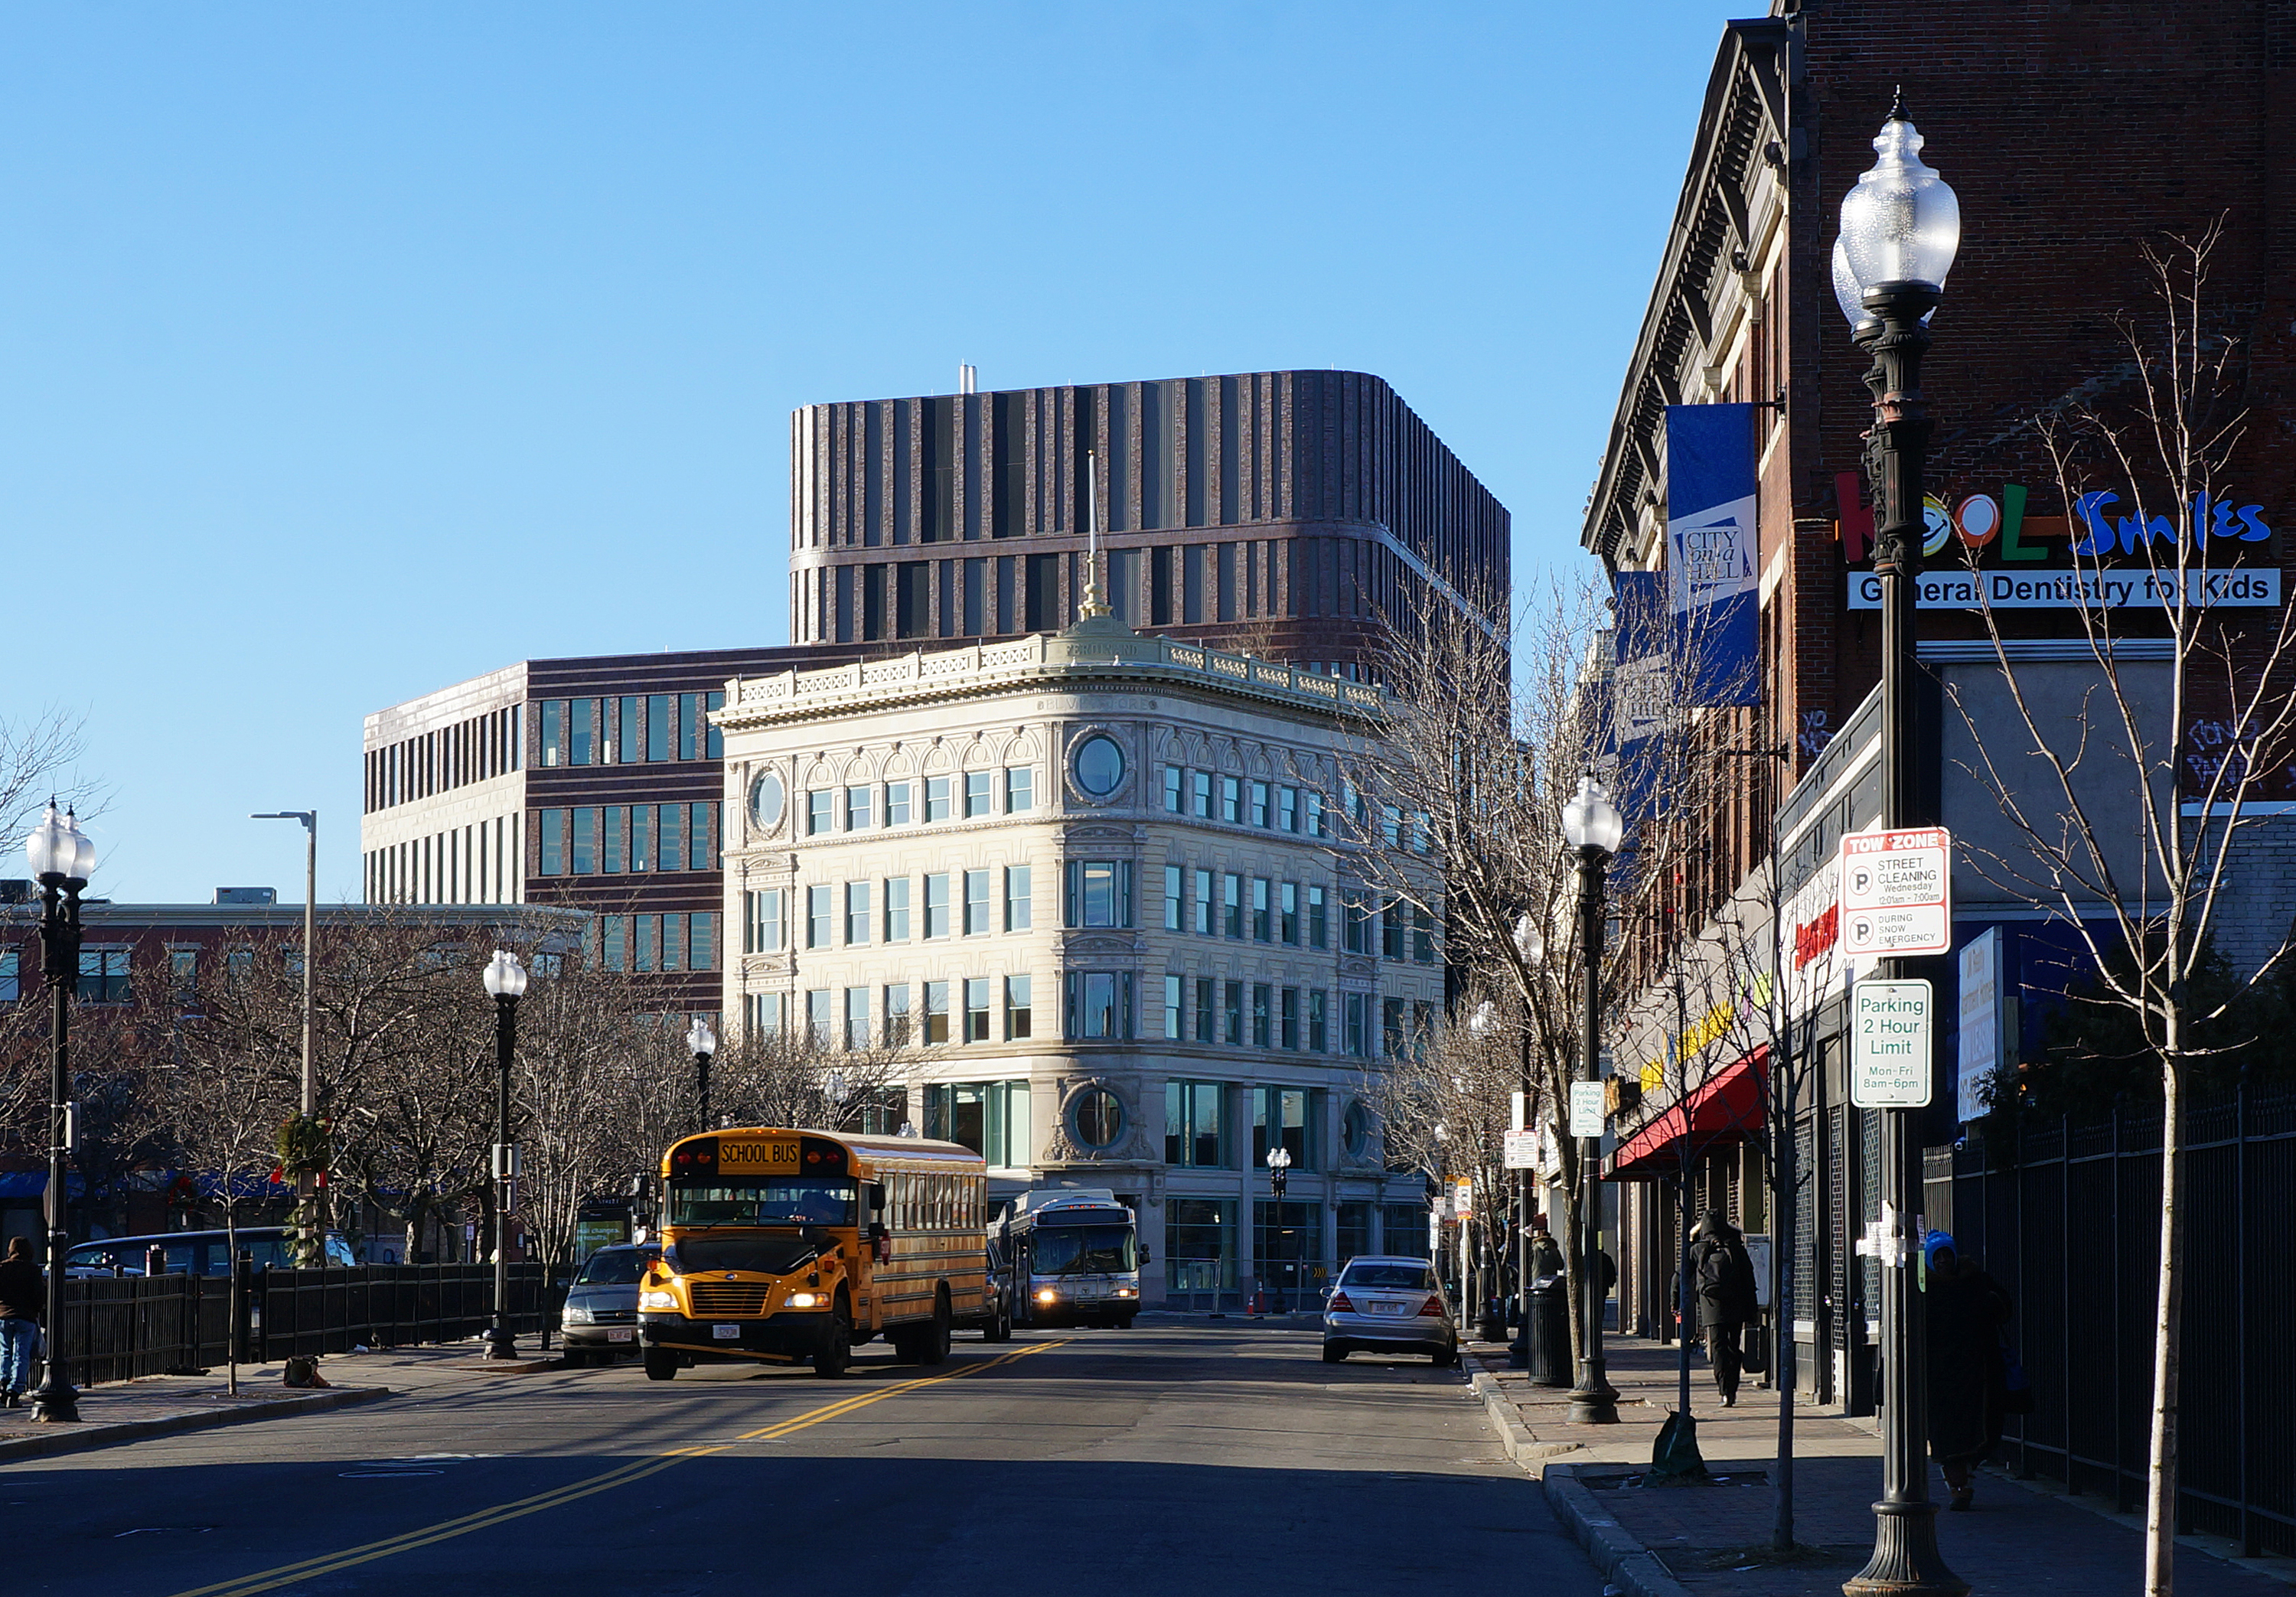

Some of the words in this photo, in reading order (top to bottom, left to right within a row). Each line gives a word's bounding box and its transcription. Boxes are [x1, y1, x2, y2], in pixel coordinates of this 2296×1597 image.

[1686, 530, 1739, 549] CITY
[1687, 562, 1740, 580] HILL
[1861, 576, 1981, 601] Gera
[1993, 575, 2134, 606] Dentistry
[2200, 575, 2269, 600] Kids
[1850, 836, 1884, 854] TOW
[1892, 833, 1939, 850] ZONE
[1878, 857, 1924, 871] STREET
[1877, 869, 1937, 885] CLEANING
[1883, 882, 1933, 893] Wednesday
[1913, 893, 1940, 902] 7:00am
[1878, 914, 1913, 924] DURING
[1879, 924, 1906, 934] SNOW
[1879, 933, 1936, 944] EMERGENCY
[1861, 997, 1924, 1016] Parking
[1864, 1018, 1874, 1033] 2
[1880, 1018, 1920, 1033] Hour
[1870, 1039, 1912, 1054] Limit
[1869, 1066, 1913, 1076] Mon-Fri
[1864, 1078, 1919, 1090] 8am-6pm
[1574, 1089, 1600, 1097] Parking
[722, 1144, 769, 1162] SCHOOL
[773, 1144, 797, 1162] BUS
